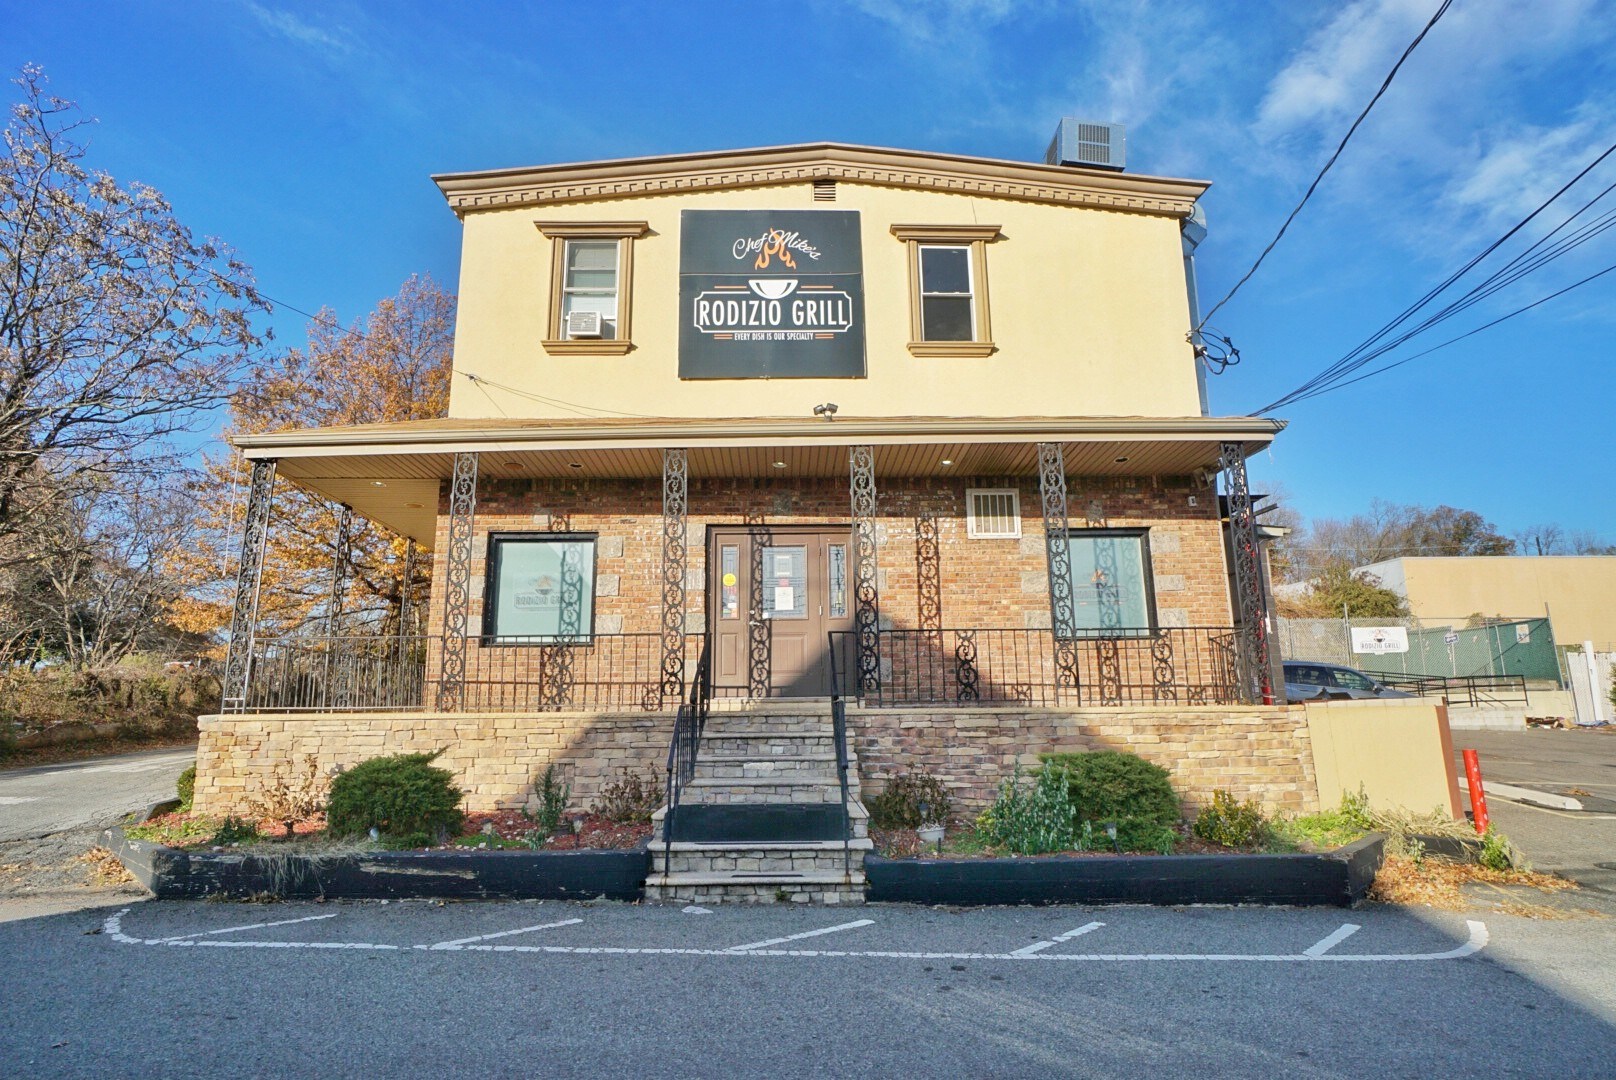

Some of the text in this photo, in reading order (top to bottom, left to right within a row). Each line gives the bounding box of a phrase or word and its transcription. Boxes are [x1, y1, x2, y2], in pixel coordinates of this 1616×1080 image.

[732, 229, 822, 261] Chef Mike's
[699, 300, 848, 326] RODIZIO GRILL
[734, 332, 814, 341] EVERY DISH IS OUR SPECIALTY
